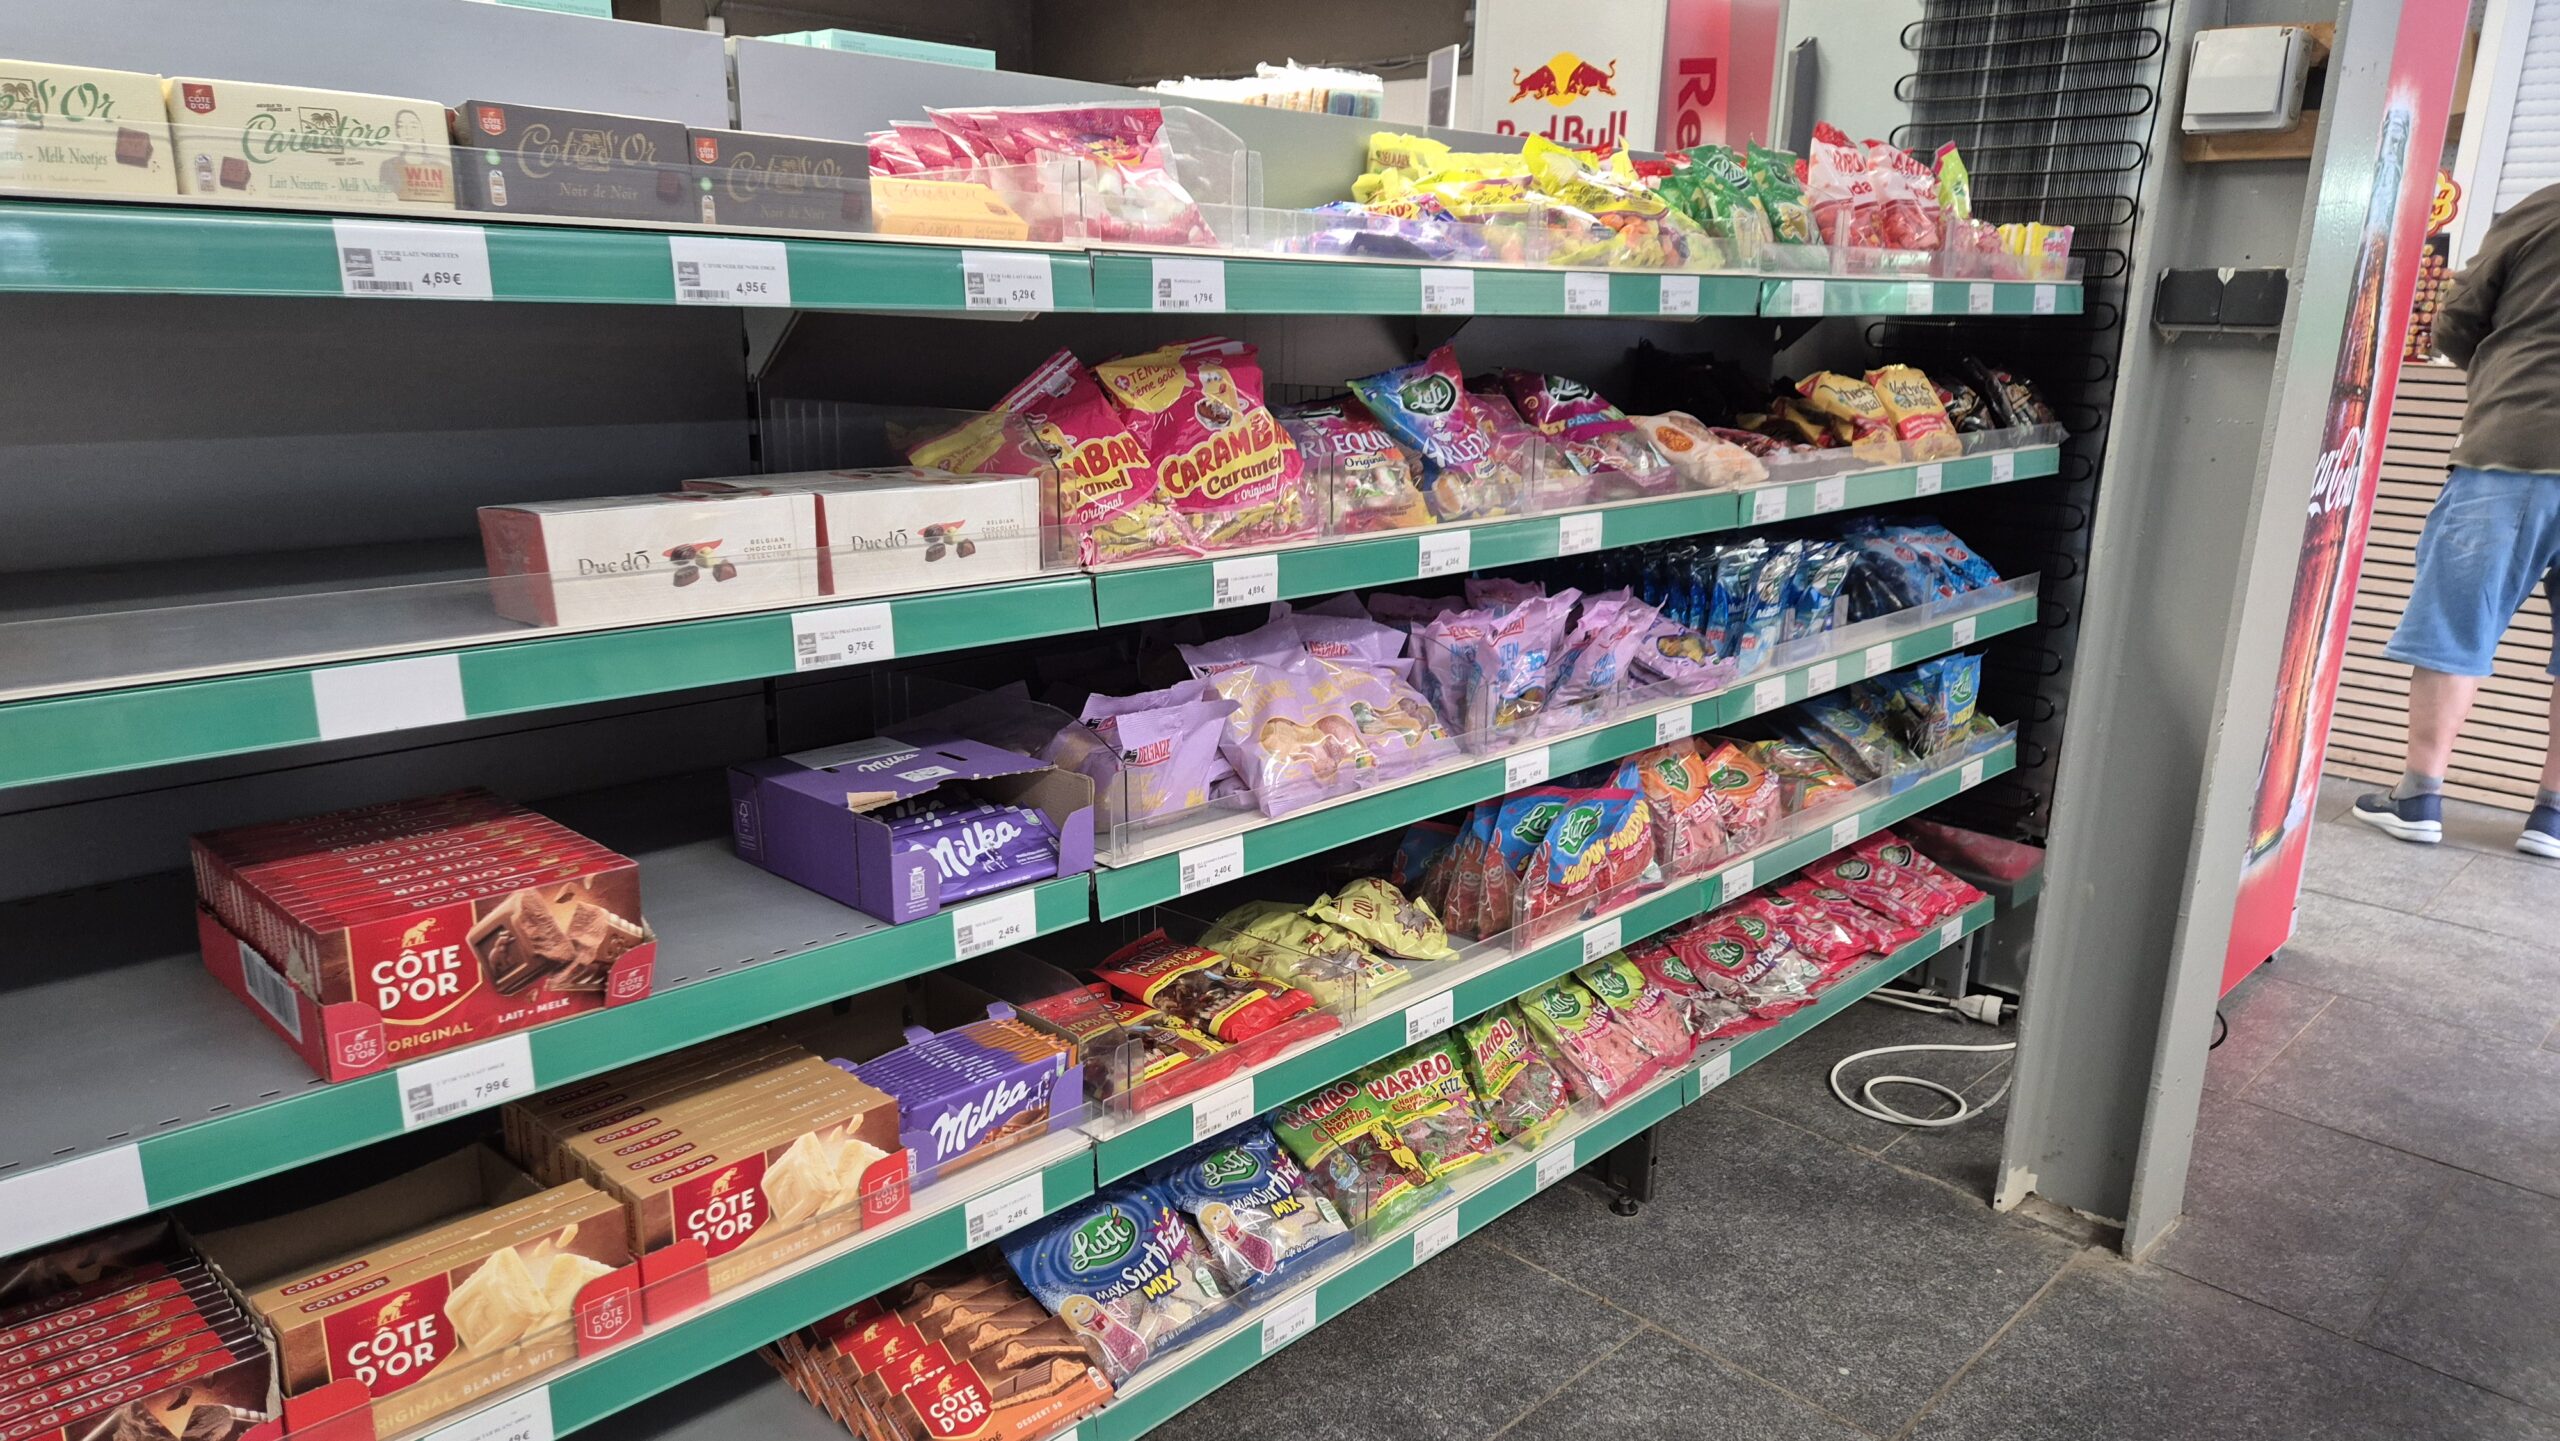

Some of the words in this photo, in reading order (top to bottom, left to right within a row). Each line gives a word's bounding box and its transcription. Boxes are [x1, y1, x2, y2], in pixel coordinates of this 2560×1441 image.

[1676, 58, 1718, 150] Re
[1563, 111, 1627, 148] Bull
[404, 166, 444, 181] WIN
[1206, 451, 1284, 497] Caramel
[1344, 453, 1386, 471] Original
[743, 543, 792, 553] CHOCOLATE
[750, 537, 785, 545] BELGIAN
[851, 535, 883, 551] Duc
[578, 557, 618, 576] Duc
[847, 640, 874, 654] 9,79€
[856, 752, 919, 773] Milka
[1515, 803, 1561, 839] Lut
[1557, 804, 1602, 851] Lutti
[928, 819, 1022, 883] Milka
[998, 924, 1020, 940] 2,49€
[370, 943, 461, 985] CÔTE
[379, 974, 460, 1012] D'OR
[618, 974, 644, 988] CÔTE
[618, 981, 644, 994] D'OR
[498, 1009, 525, 1024] LAIT
[536, 997, 570, 1014] MELK
[344, 1038, 377, 1055] CÔTE
[386, 1021, 475, 1052] ORIGINAL
[346, 1047, 377, 1063] D'OR
[475, 1077, 510, 1099] 7,99€
[1366, 1052, 1454, 1101] HARIBO
[854, 1098, 870, 1109] WIT
[1282, 1081, 1360, 1130] HARIBO
[1397, 1093, 1423, 1106] Happy
[632, 1119, 659, 1133] D'OR
[930, 1079, 1031, 1162] Milka
[1312, 1108, 1372, 1142] Cherries
[1321, 1106, 1354, 1128] Happy
[618, 1141, 648, 1156] CÔTE
[650, 1131, 679, 1144] D'OR
[632, 1154, 664, 1169] CÔTE
[666, 1143, 694, 1157] D'OR
[652, 1167, 683, 1183] CÔTE
[685, 1155, 714, 1170] D'OR
[1203, 1147, 1255, 1188] Lutti
[687, 1188, 756, 1230] CÔTE
[875, 1194, 899, 1211] D'OR
[1007, 1207, 1028, 1224] 2,49€
[1271, 1198, 1304, 1220] MIX
[692, 1212, 754, 1247] D'OR
[285, 1276, 327, 1296] CÔTE
[329, 1261, 369, 1279] D'OR
[494, 1203, 534, 1221] BLANC
[548, 1190, 566, 1203] WIT
[1072, 1217, 1134, 1271] Lutti
[304, 1293, 350, 1313] CÔTE
[351, 1276, 390, 1296] D'OR
[516, 1216, 556, 1237] BLANC
[570, 1204, 589, 1217] WIT
[1096, 1280, 1128, 1302] MAXI
[1142, 1269, 1181, 1301] MIX
[592, 1304, 625, 1325] CÔTE
[594, 1315, 623, 1336] D'OR
[347, 1314, 438, 1367] CÔTE
[356, 1343, 436, 1390] D'OR
[374, 1391, 458, 1433] RIGINAL
[463, 1369, 514, 1394] BLANC
[529, 1347, 556, 1367] WIT
[929, 1385, 980, 1419] CÔTE
[939, 1400, 988, 1434] D'OR
[1015, 1408, 1051, 1430] DESSERT
